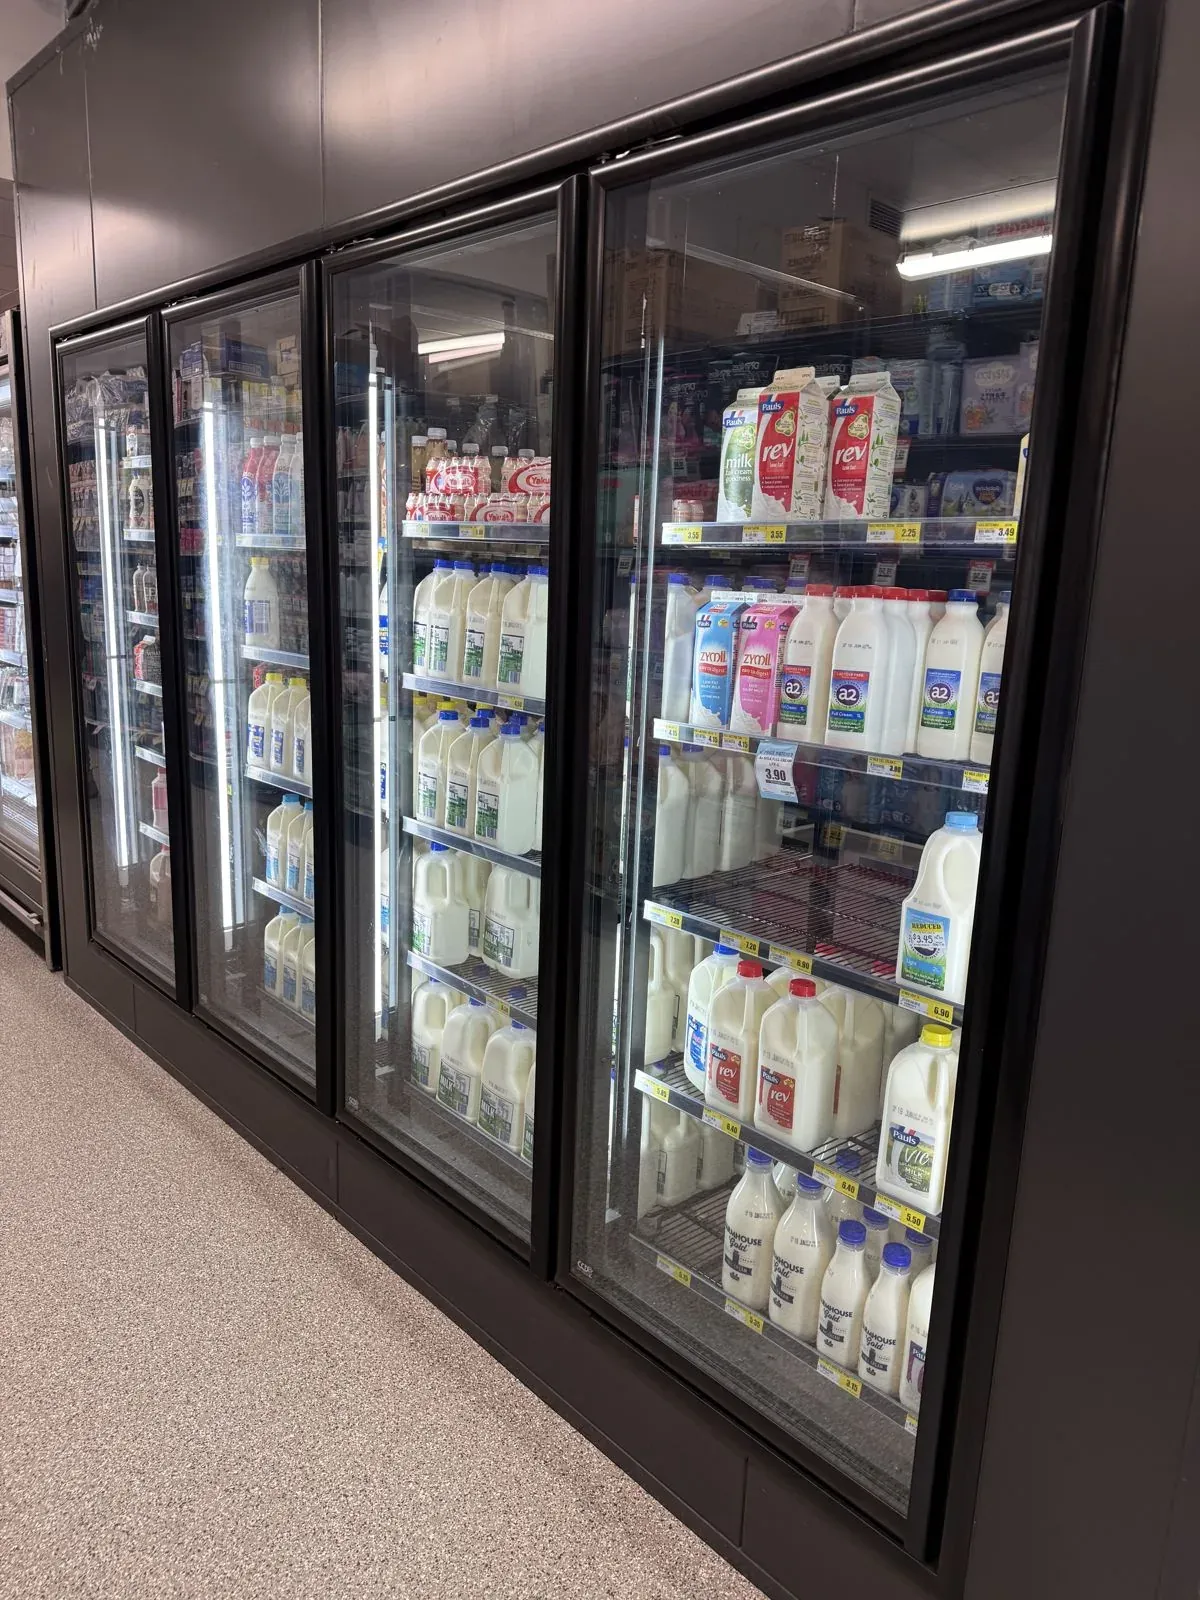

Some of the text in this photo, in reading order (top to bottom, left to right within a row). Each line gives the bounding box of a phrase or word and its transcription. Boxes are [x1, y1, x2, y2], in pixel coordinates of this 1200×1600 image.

[762, 402, 781, 411] Pauls
[836, 406, 855, 415] Pauls
[726, 418, 743, 426] Pauls
[762, 439, 794, 462] rev
[835, 442, 867, 465] rev
[726, 453, 752, 469] milk
[531, 476, 550, 484] Yaku
[688, 531, 699, 540] 3.55
[770, 530, 783, 539] 3.55
[901, 528, 916, 538] 2.25
[998, 527, 1015, 537] 3.49
[786, 682, 801, 695] a2
[838, 687, 857, 701] a2
[931, 686, 948, 700] a2
[765, 768, 786, 781] 3.90
[912, 922, 942, 930] REDUCED
[912, 933, 934, 944] $3.45
[745, 941, 757, 951] 7.20
[796, 960, 810, 970] 6.90
[934, 1006, 950, 1018] 6.90
[719, 1066, 737, 1078] rev
[762, 1071, 779, 1084] Pauls
[770, 1089, 791, 1103] rev
[726, 1123, 738, 1134] 6.40
[893, 1129, 916, 1145] Pauls
[905, 1167, 923, 1178] MILK
[841, 1180, 855, 1194] 6.40
[906, 1213, 921, 1226] 5.50
[724, 1225, 762, 1246] RMHOUSE
[820, 1299, 853, 1318] RMHOUSE
[862, 1325, 896, 1346] RMHOUSE
[913, 1348, 925, 1361] Pau
[846, 1379, 858, 1391] 3.15
